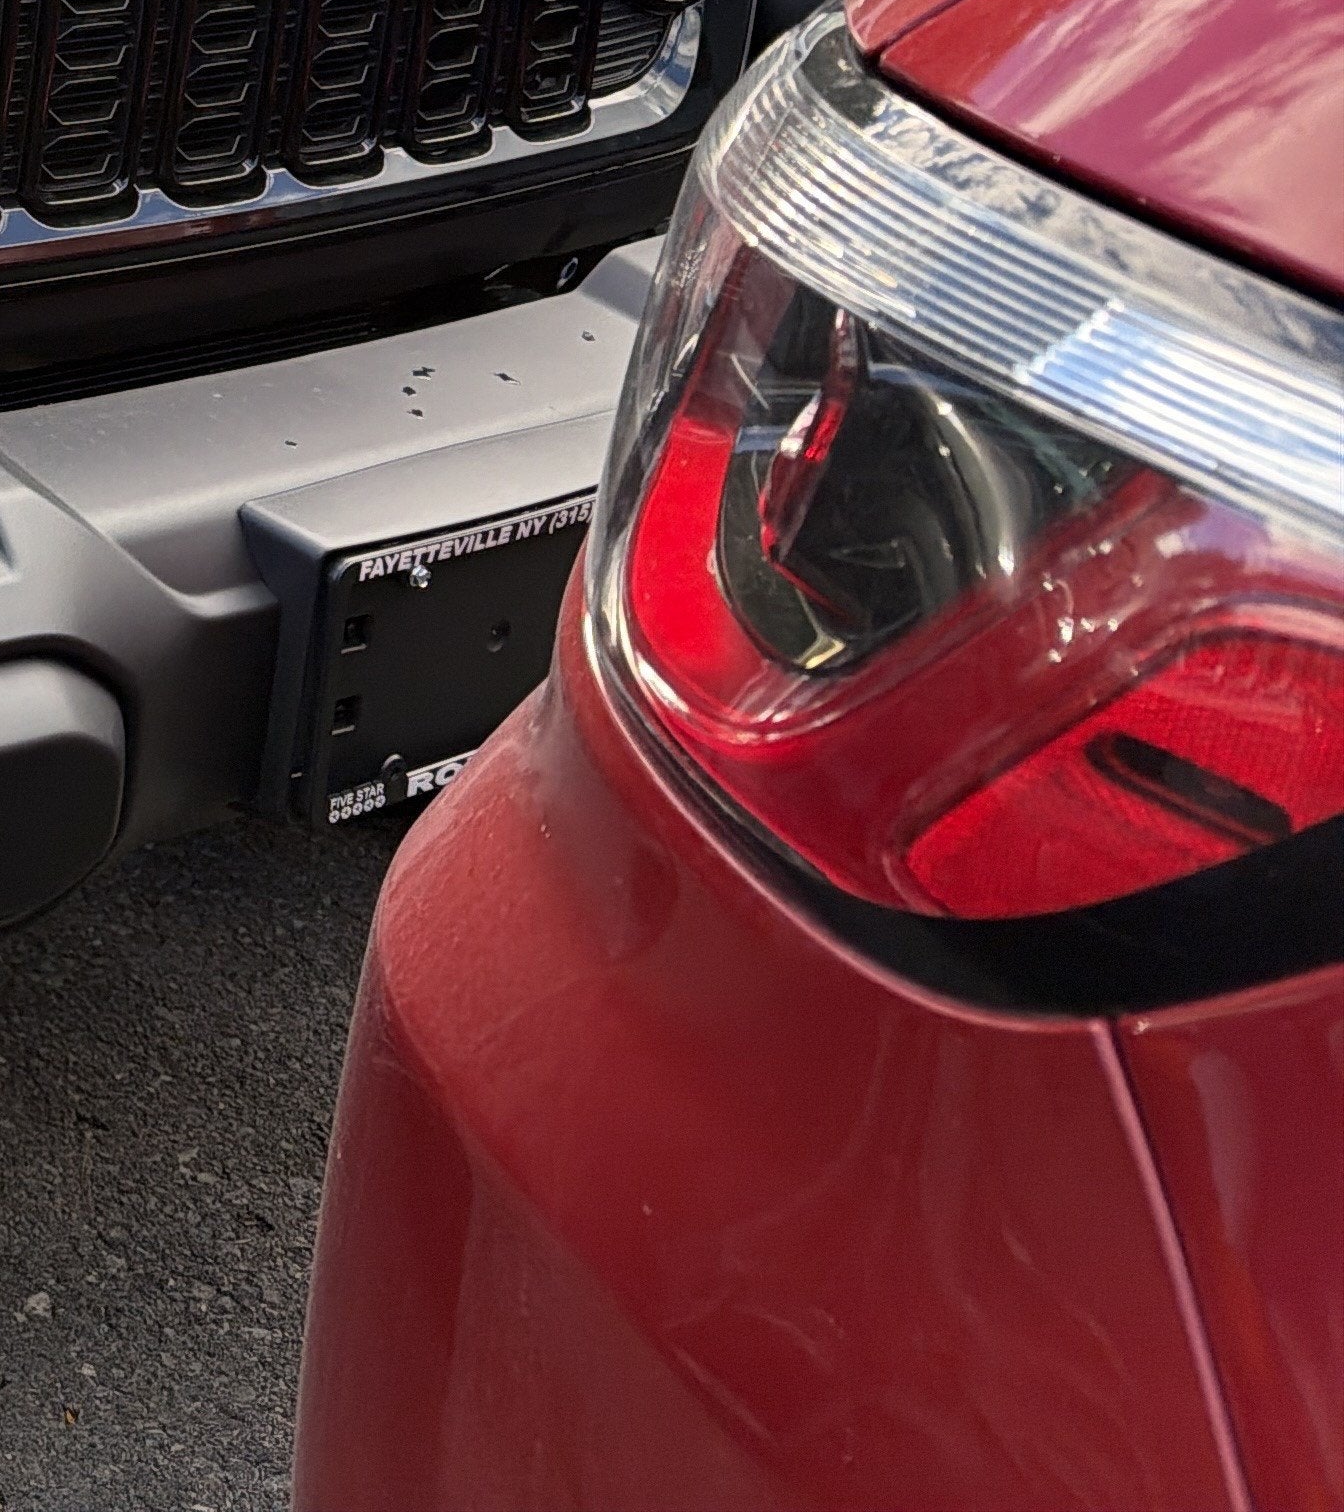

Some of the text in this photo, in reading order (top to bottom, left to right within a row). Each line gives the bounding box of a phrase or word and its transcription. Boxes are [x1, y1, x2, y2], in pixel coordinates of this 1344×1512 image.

[358, 525, 514, 582] FAYETTEVILLE
[515, 514, 548, 541] NY
[329, 781, 386, 812] FIVE STAR
[406, 756, 472, 798] RO
